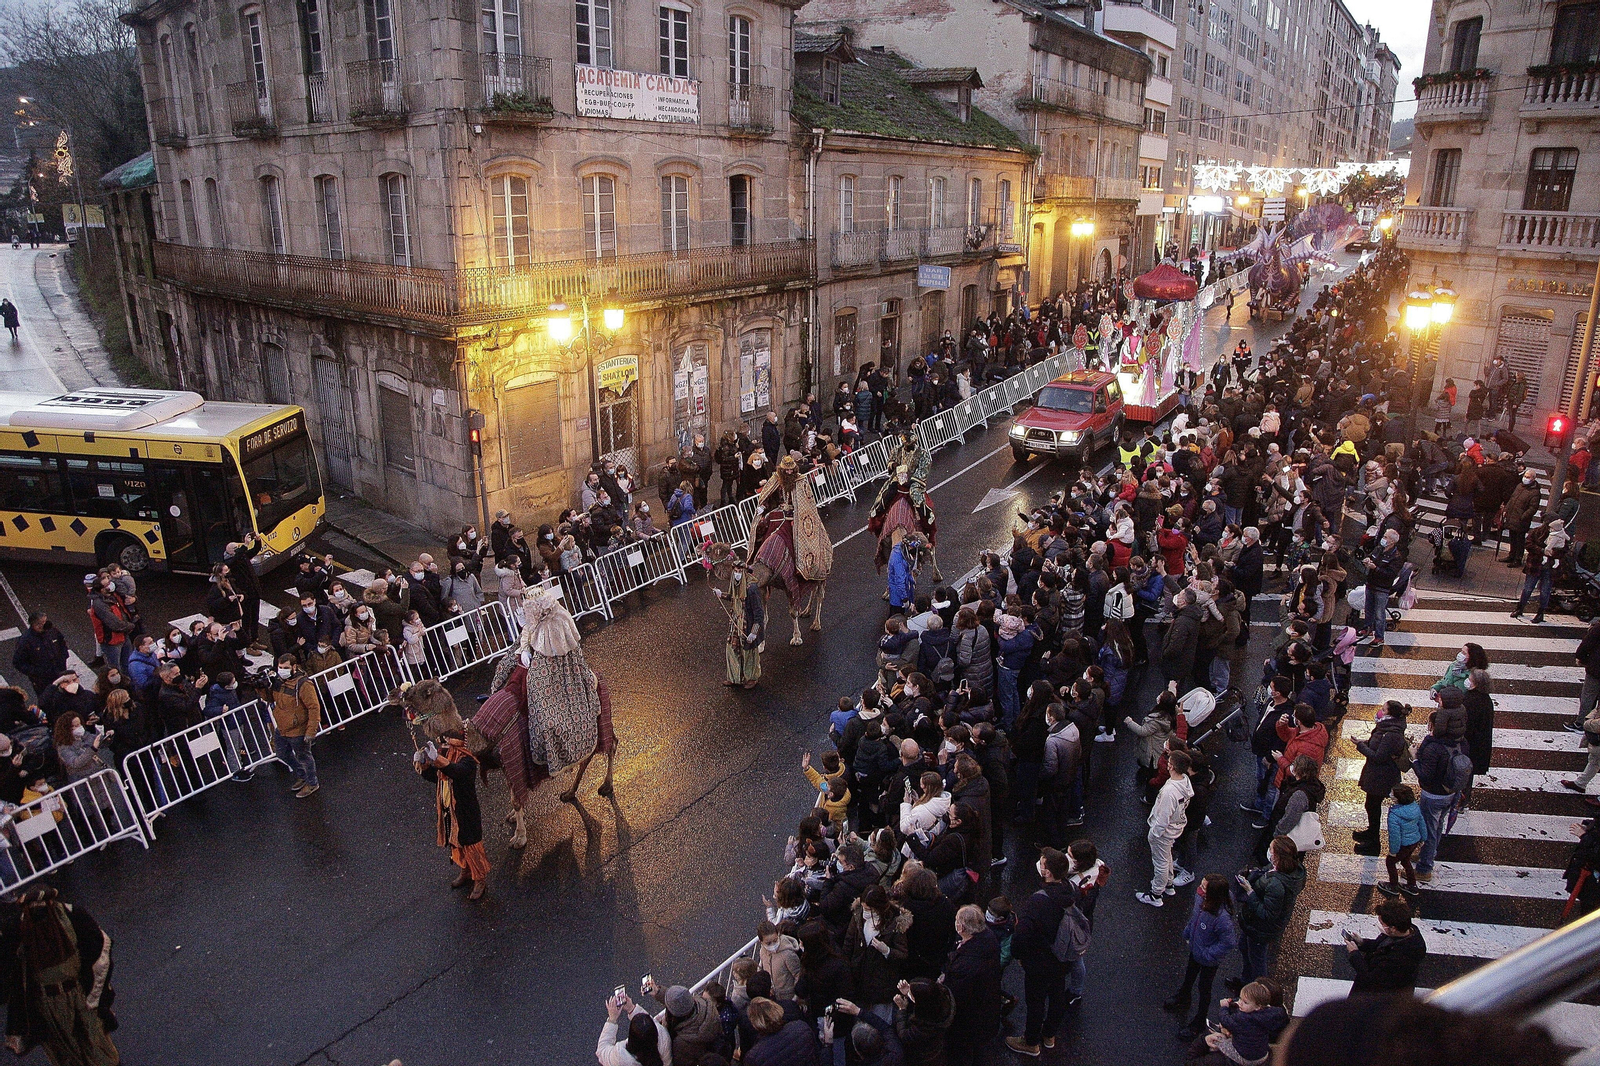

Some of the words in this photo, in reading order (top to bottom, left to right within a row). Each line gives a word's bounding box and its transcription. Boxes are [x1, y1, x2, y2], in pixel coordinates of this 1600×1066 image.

[579, 68, 641, 90] ACADEMIA
[646, 76, 699, 96] CALDAS
[584, 89, 634, 100] RECUPERACIONES
[585, 99, 635, 109] EGB-BUP-COU-FP
[658, 96, 690, 105] INFORMATICA
[585, 108, 609, 116] IDIOMAS
[597, 357, 637, 373] ESTANTERIAS
[246, 434, 263, 453] FORA
[263, 429, 273, 445] DE
[272, 417, 298, 440] SERVIZO
[124, 480, 146, 488] VIZO
